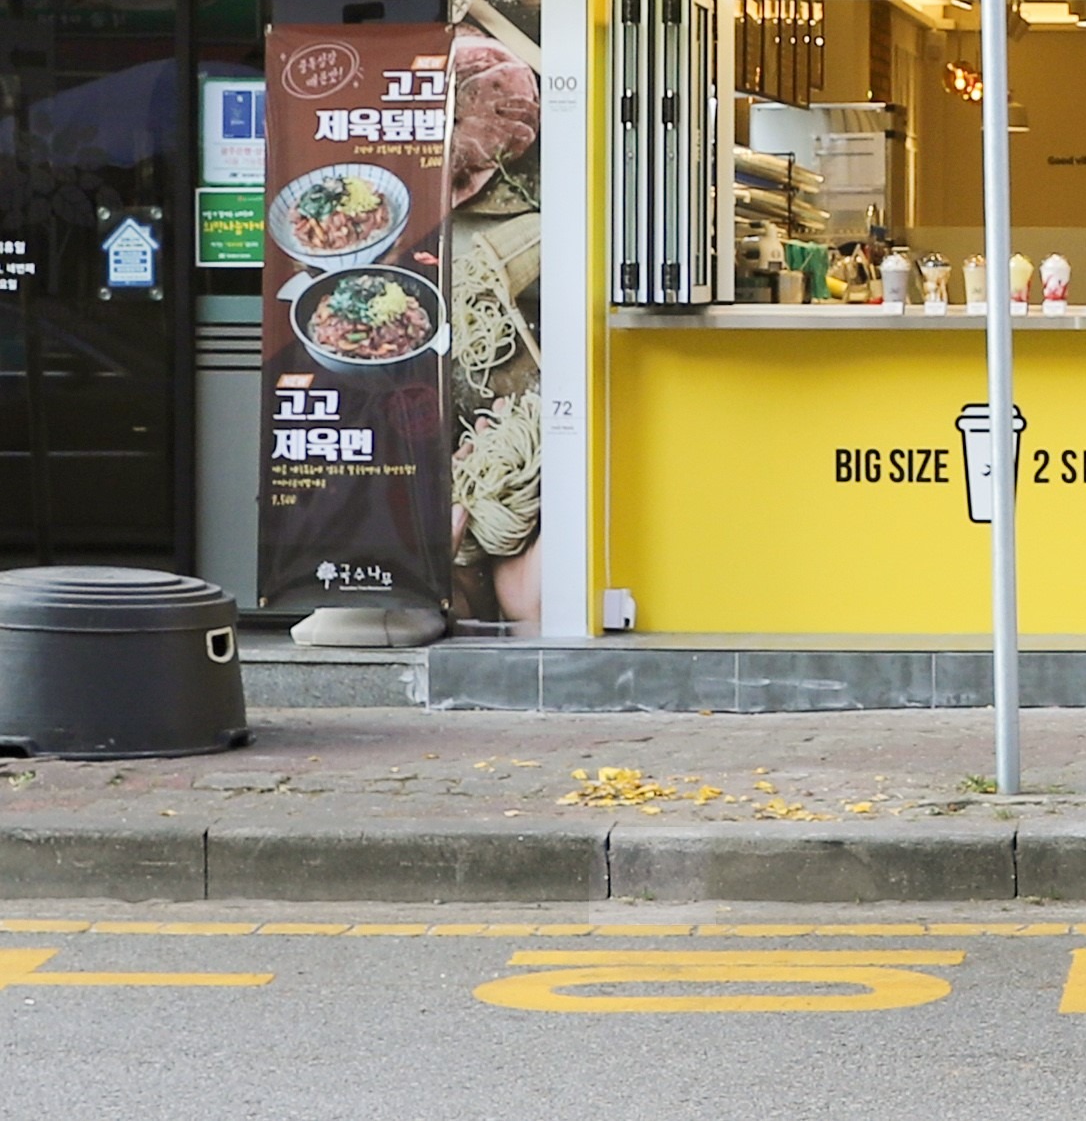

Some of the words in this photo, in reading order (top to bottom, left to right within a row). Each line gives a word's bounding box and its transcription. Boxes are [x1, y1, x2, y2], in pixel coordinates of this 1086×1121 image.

[380, 70, 446, 102] 고고
[548, 75, 577, 91] 100
[314, 108, 446, 142] 제육덮밥
[272, 390, 341, 421] 고고
[551, 400, 573, 416] 72
[271, 428, 374, 462] 제육면
[835, 449, 881, 483] BIG
[889, 449, 949, 483] SIZE
[1033, 450, 1050, 483] 2
